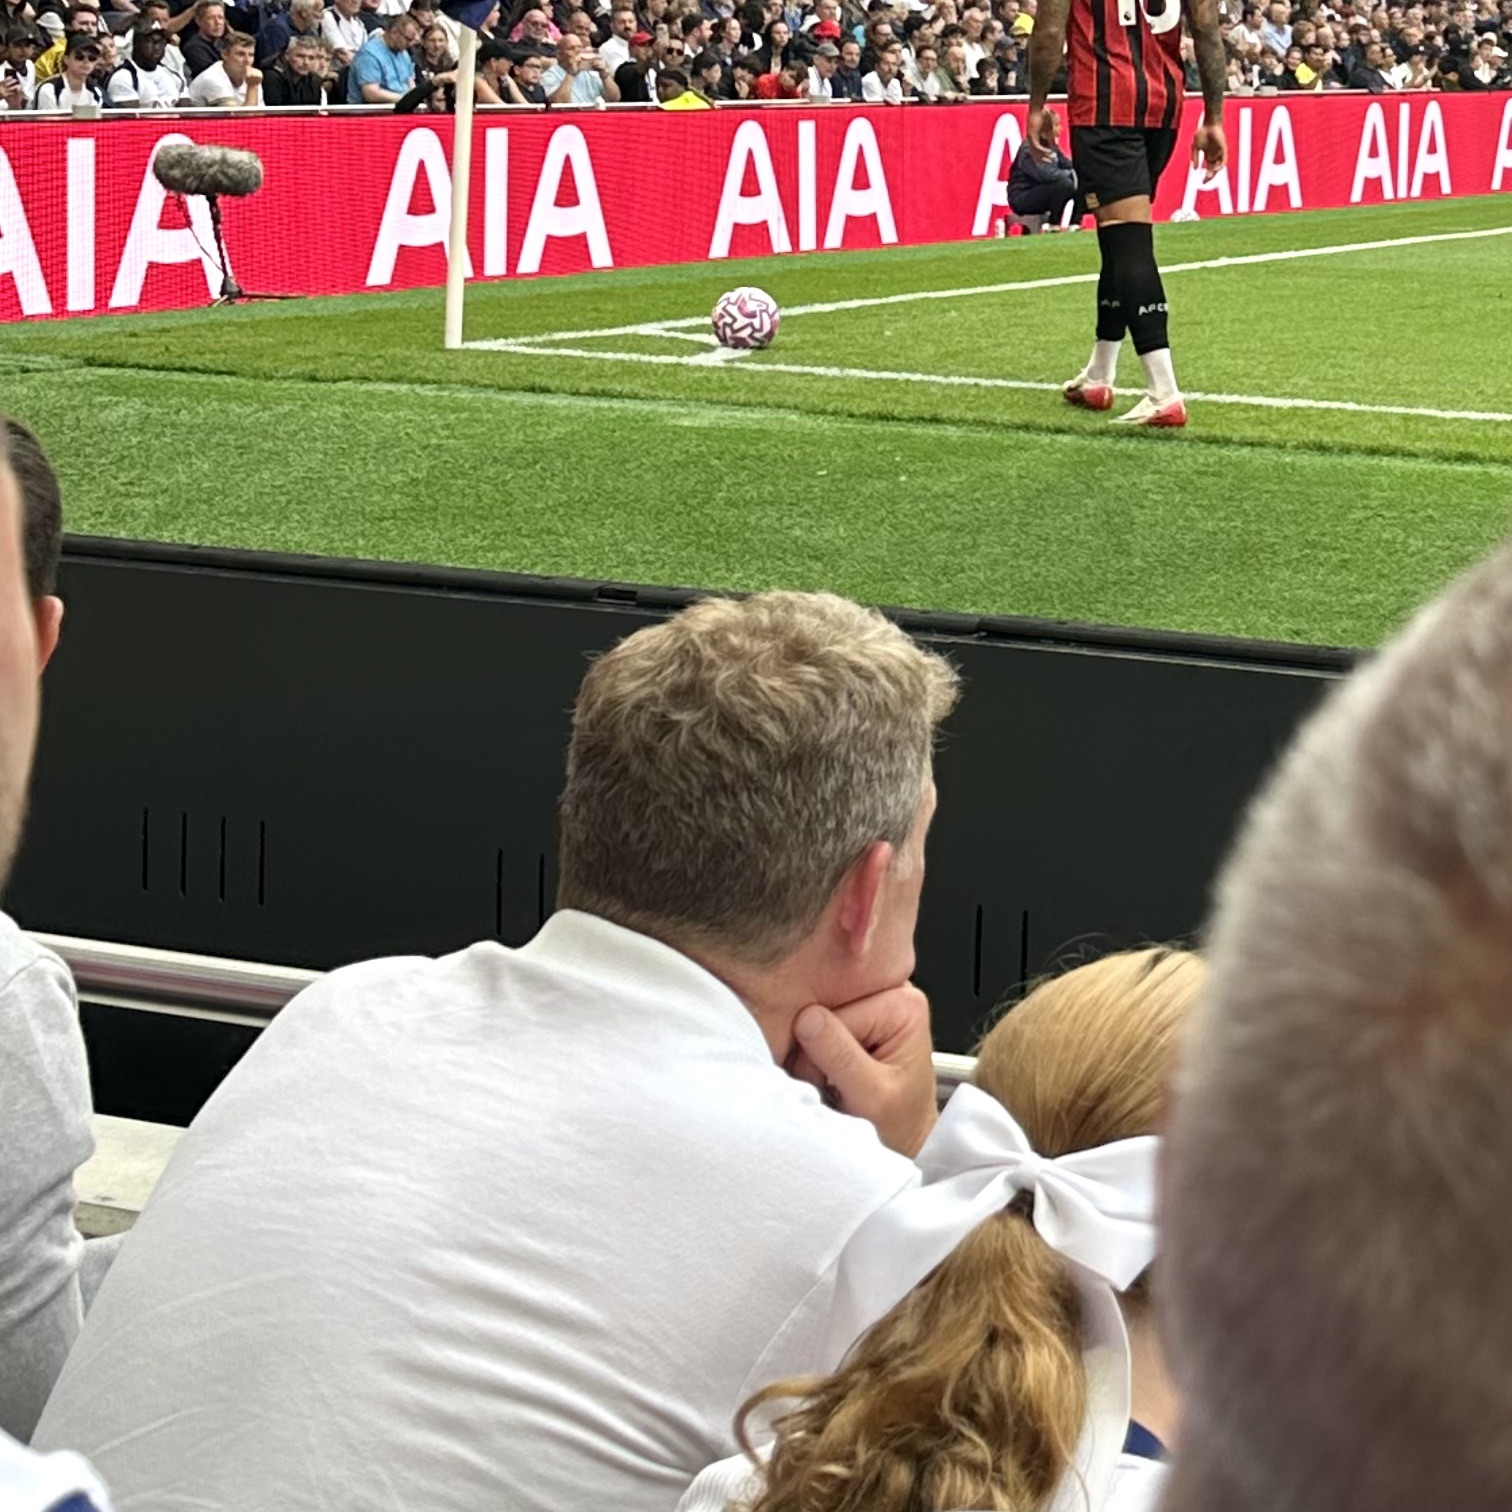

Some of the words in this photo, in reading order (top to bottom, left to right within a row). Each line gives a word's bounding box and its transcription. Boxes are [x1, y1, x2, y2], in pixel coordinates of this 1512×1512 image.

[365, 124, 614, 287] AIA
[708, 115, 899, 260] AIA
[1350, 100, 1452, 203] AIA
